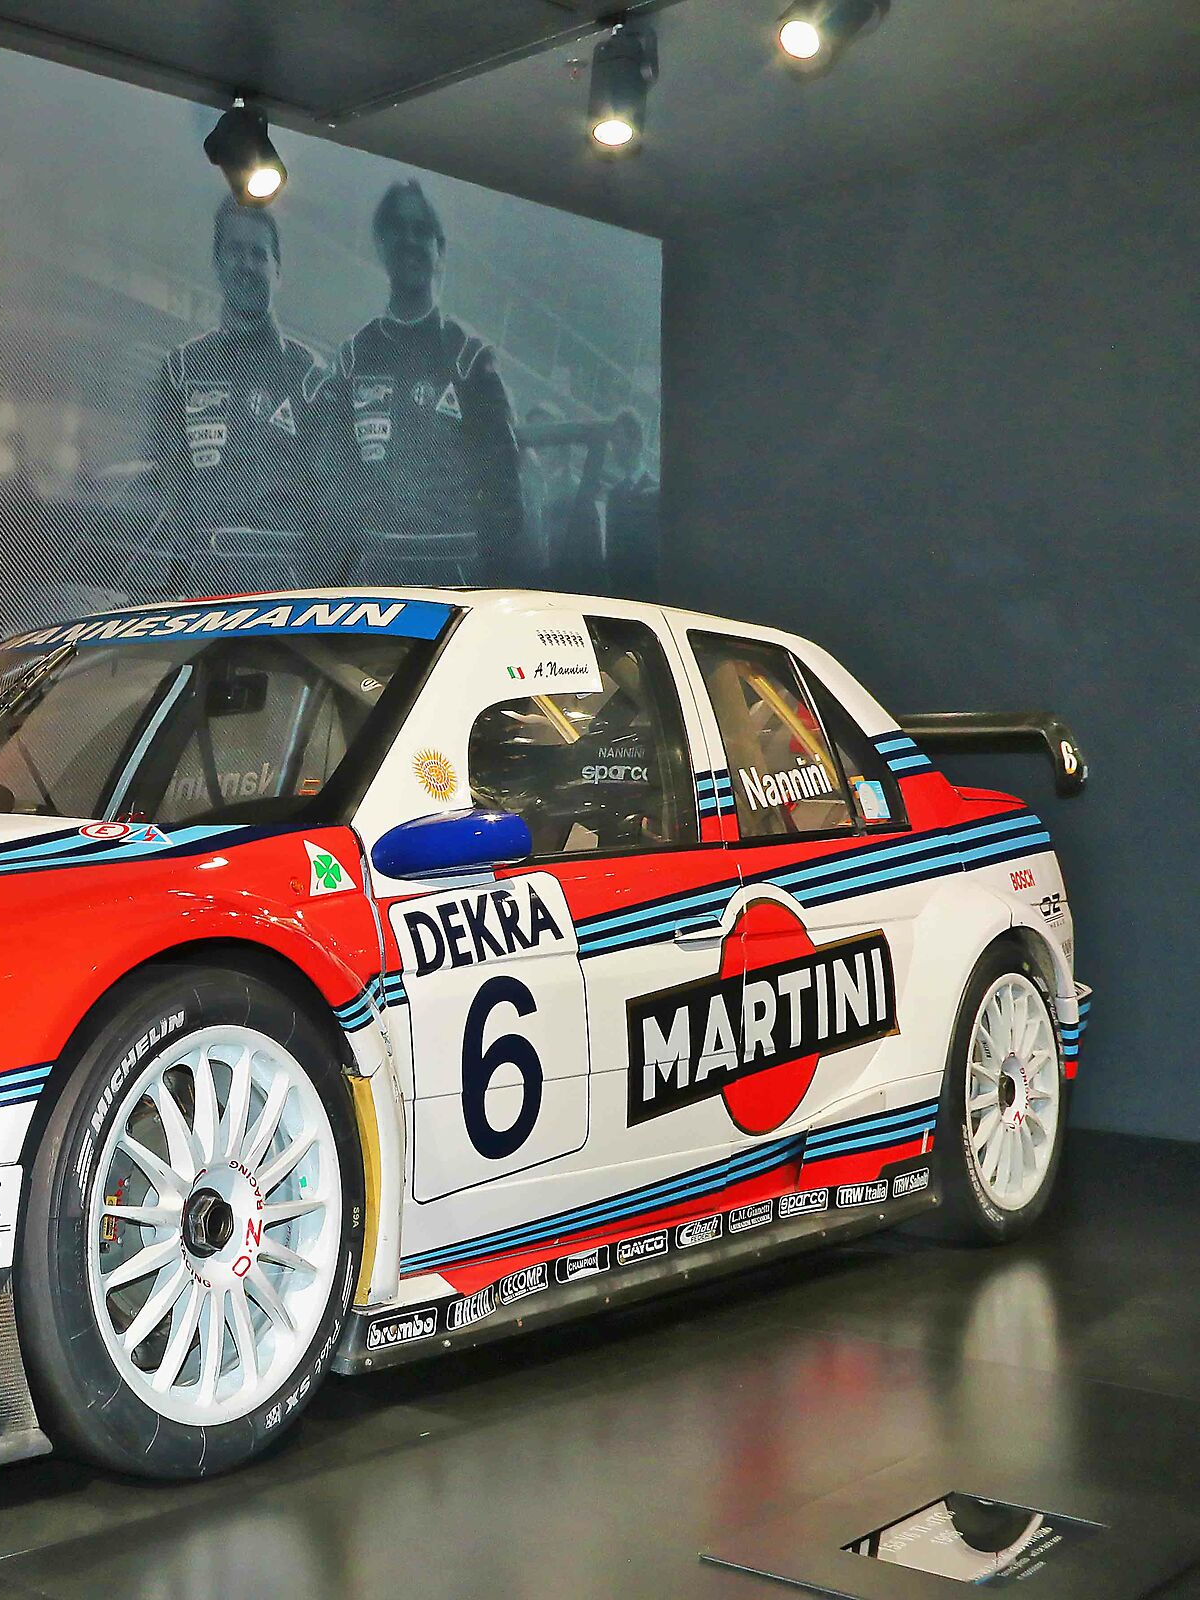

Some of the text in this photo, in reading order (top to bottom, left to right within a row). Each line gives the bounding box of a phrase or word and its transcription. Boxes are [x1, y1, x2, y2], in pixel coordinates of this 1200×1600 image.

[1059, 740, 1079, 775] 6
[738, 754, 833, 812] Nannini
[410, 882, 564, 977] DEKRA
[642, 947, 888, 1102] MARTINI
[91, 1010, 184, 1136] MICHELIN
[462, 975, 544, 1160] 6
[780, 1191, 826, 1214] sparco
[838, 1184, 887, 1206] TRW Italia
[680, 1216, 719, 1245] Eibach
[621, 1235, 664, 1259] DAYCO
[567, 1255, 598, 1273] CHAMPION
[502, 1266, 543, 1297] CECOMP
[369, 1314, 434, 1344] brembo
